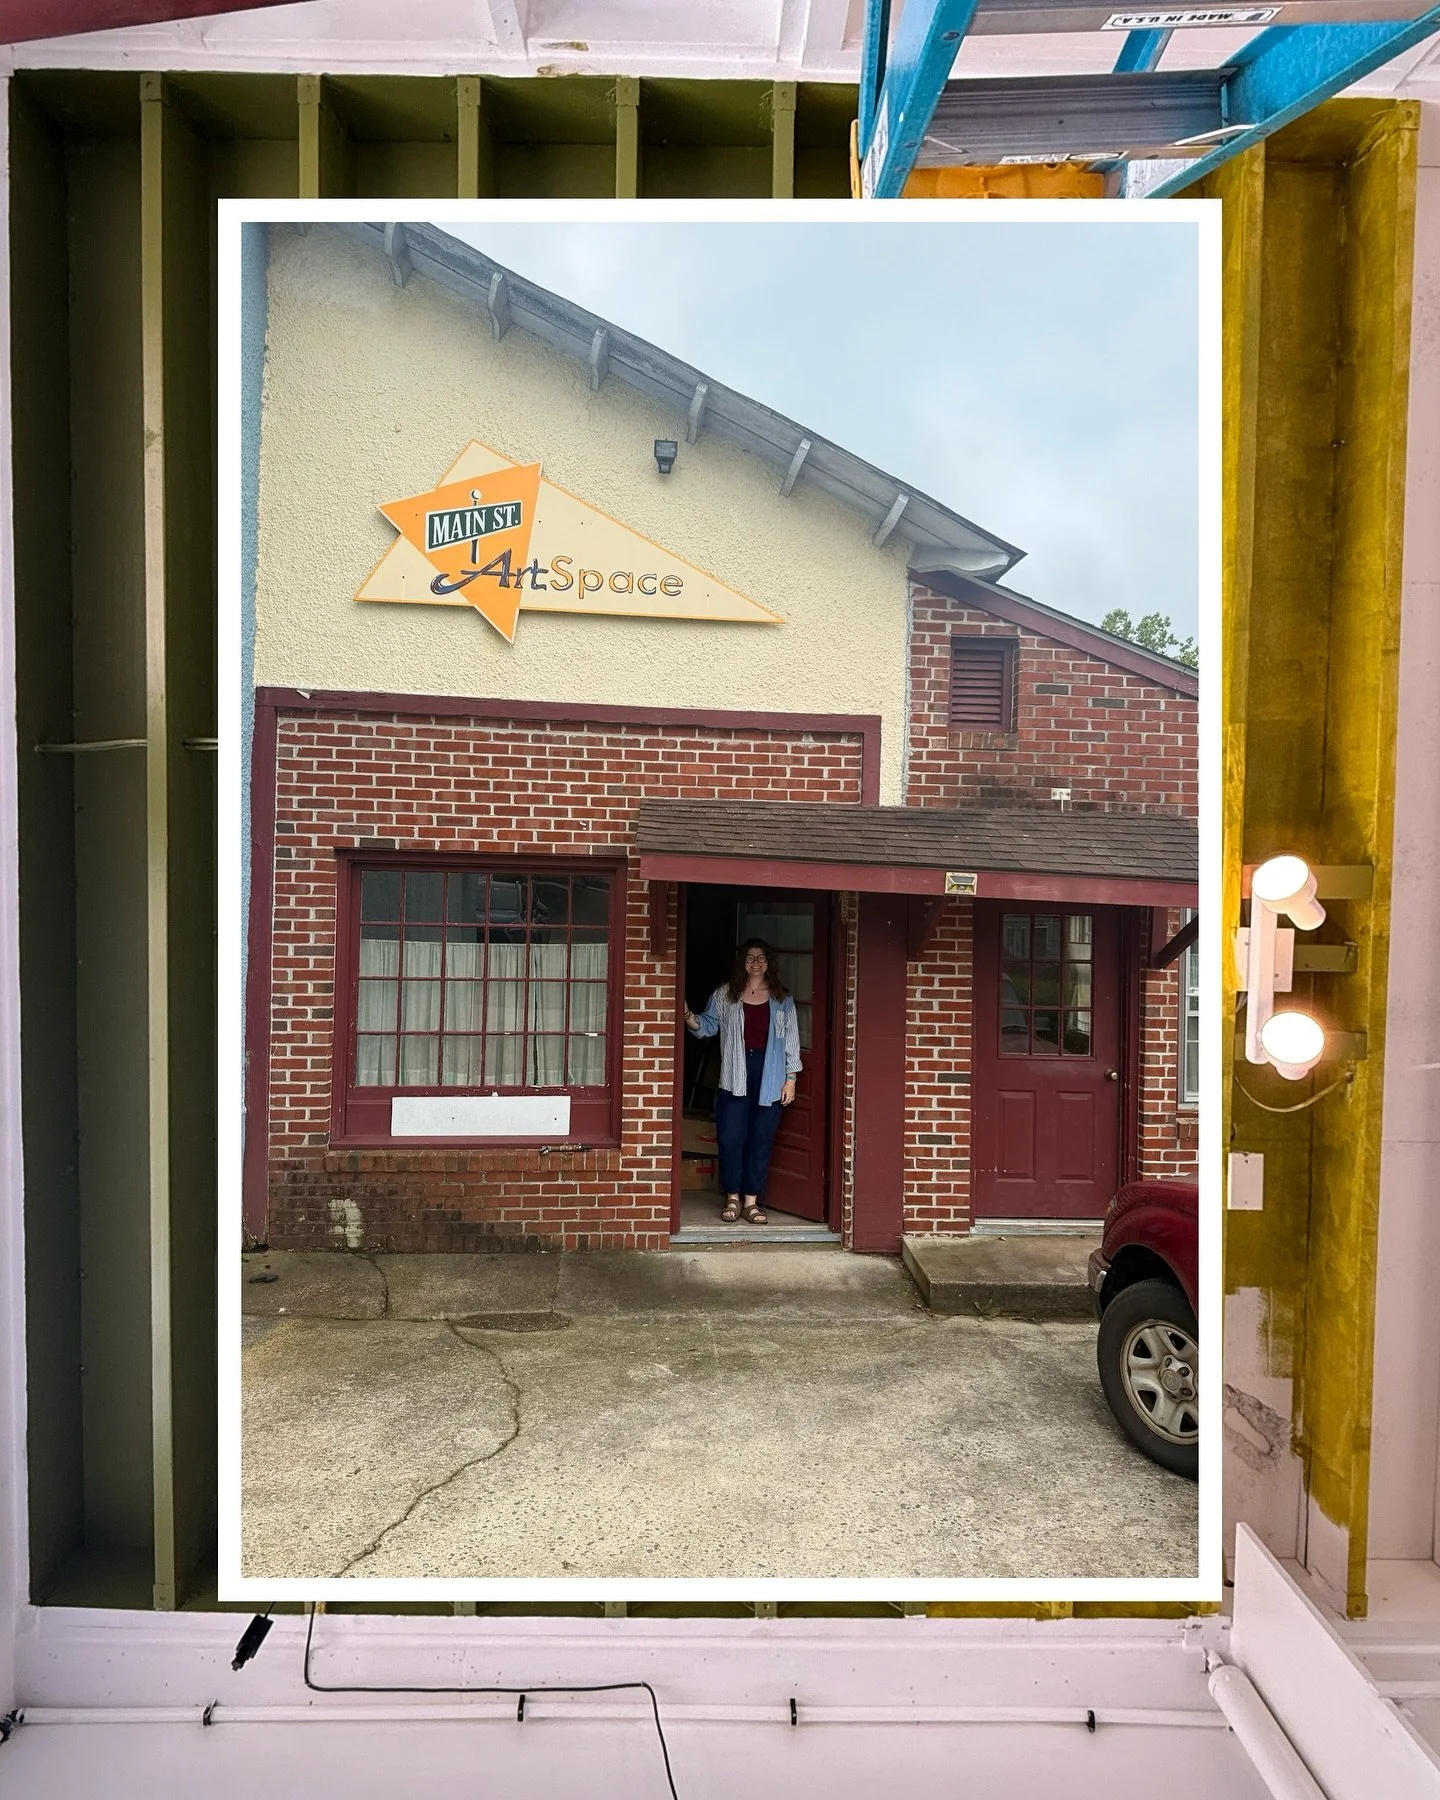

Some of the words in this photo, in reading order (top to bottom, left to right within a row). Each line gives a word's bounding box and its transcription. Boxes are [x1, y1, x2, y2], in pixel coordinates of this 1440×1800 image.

[1187, 13, 1233, 21] MADE
[432, 509, 486, 545] MAIN
[492, 505, 519, 530] ST.
